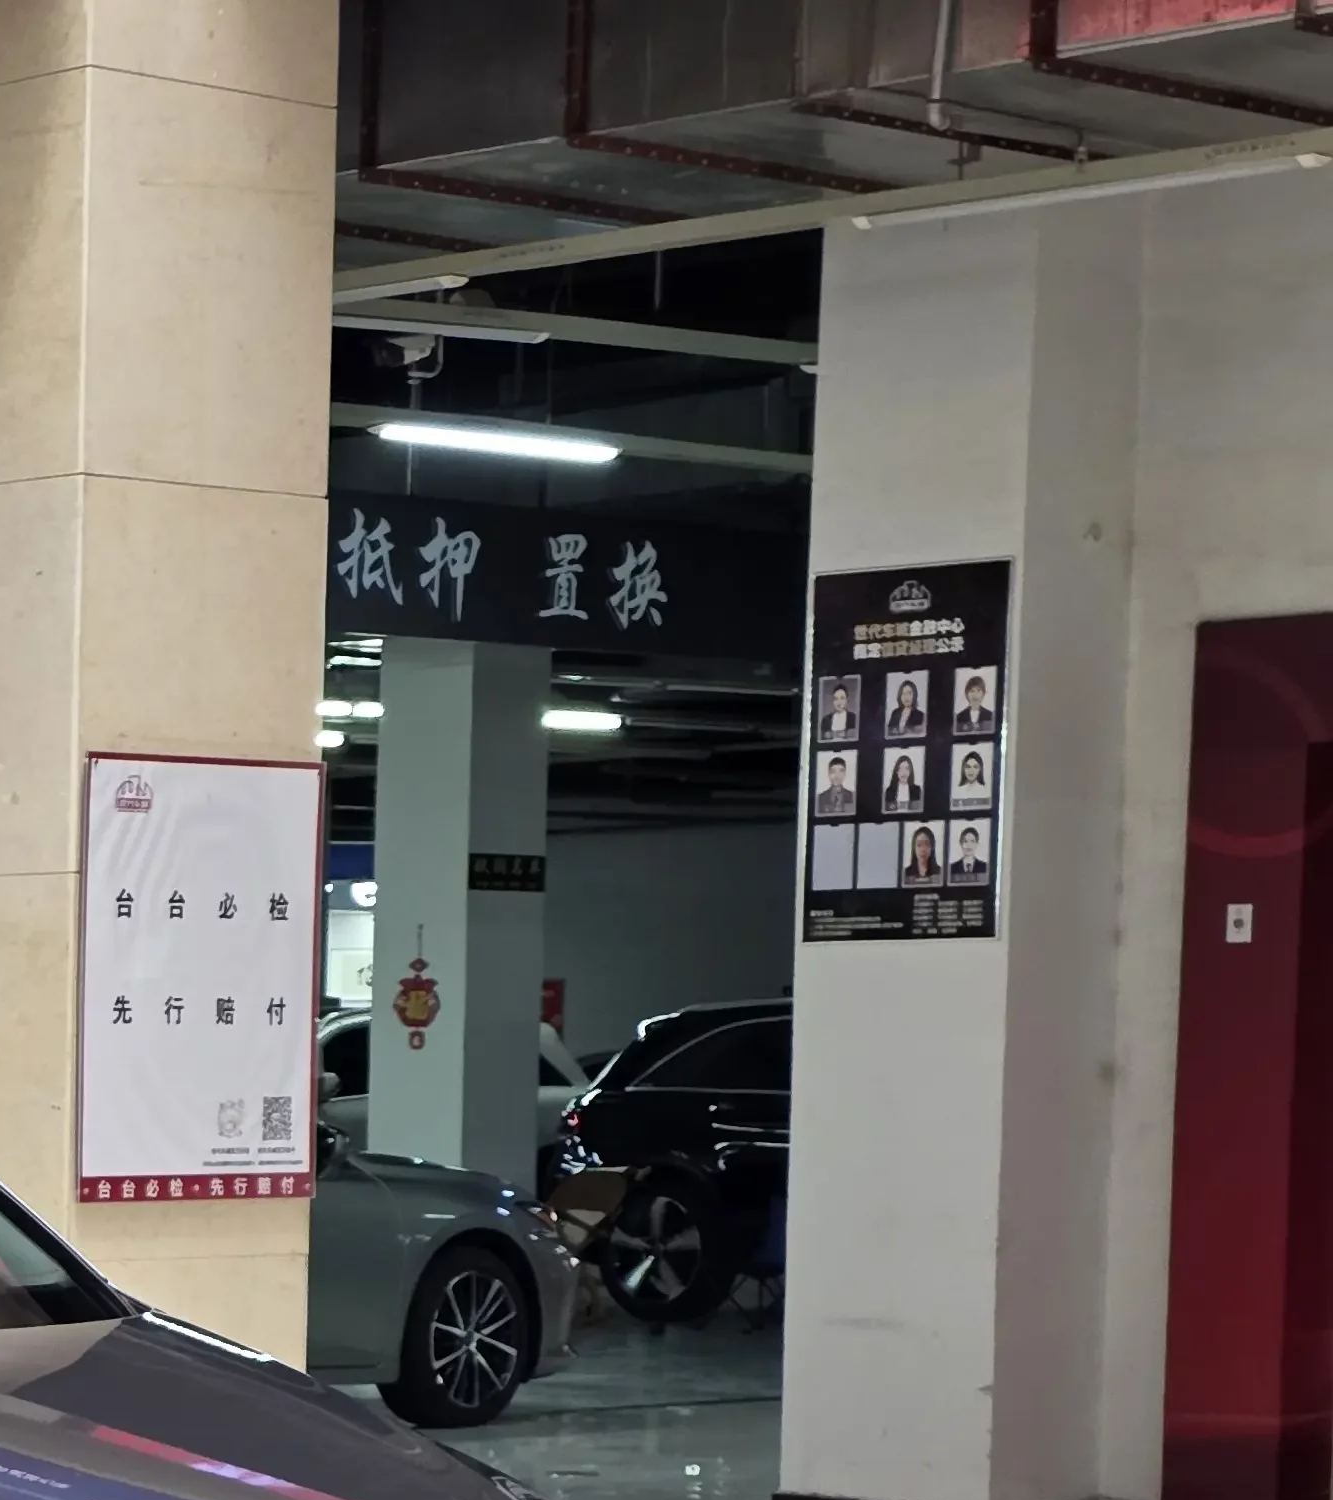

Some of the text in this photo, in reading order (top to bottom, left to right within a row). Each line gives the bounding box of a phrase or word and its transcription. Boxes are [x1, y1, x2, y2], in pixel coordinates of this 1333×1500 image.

[336, 507, 669, 630] 抵押 置换
[114, 887, 291, 922] 台台必检
[112, 995, 288, 1027] 先行赔付
[98, 1176, 295, 1199] 台台必检 先行赔付
